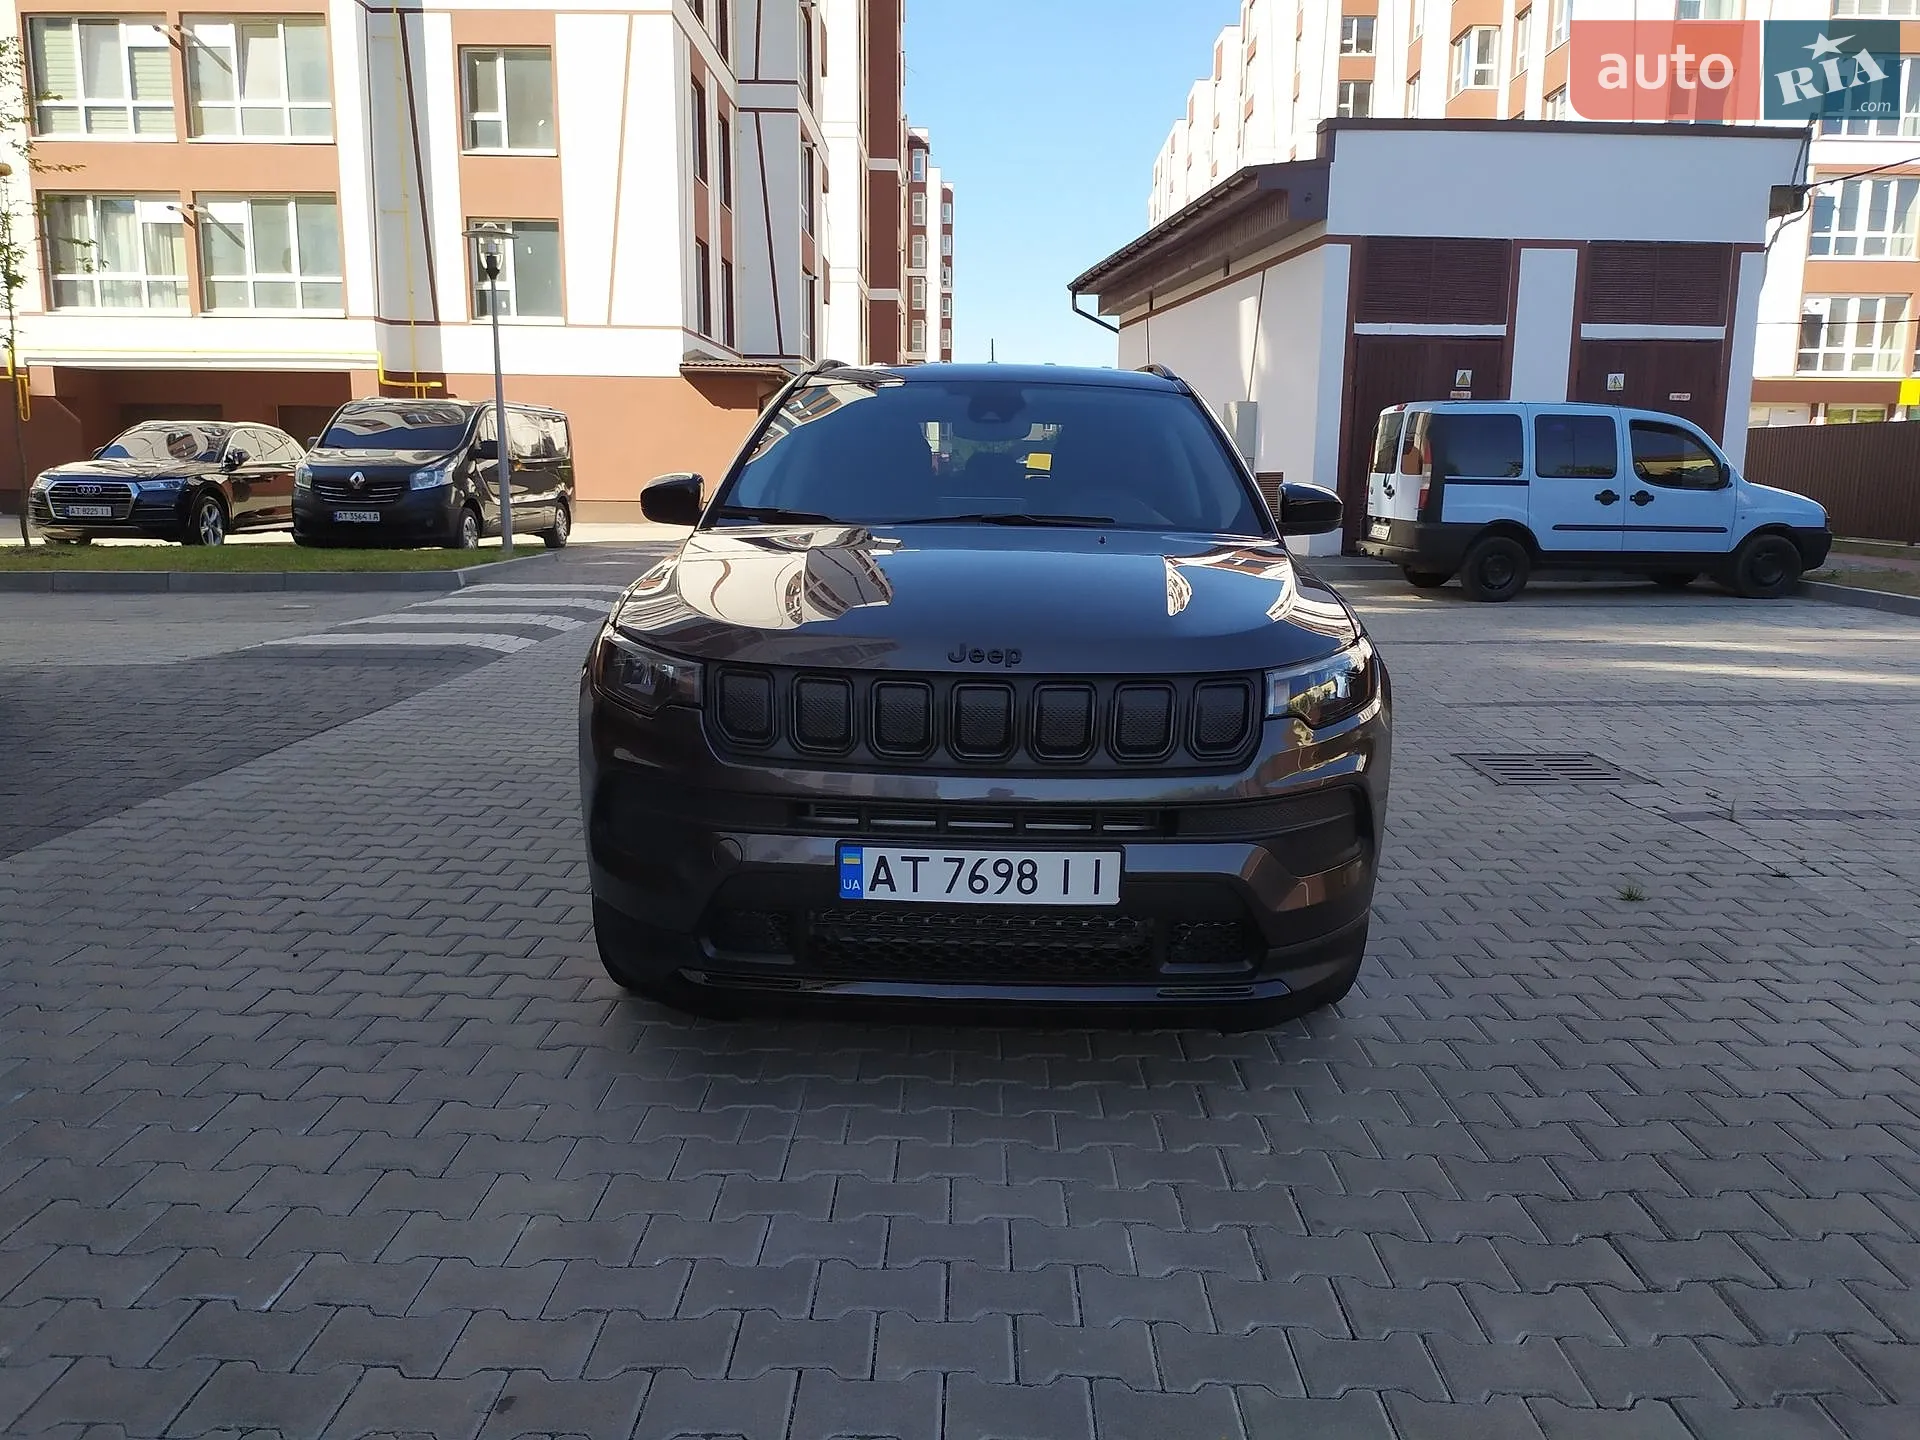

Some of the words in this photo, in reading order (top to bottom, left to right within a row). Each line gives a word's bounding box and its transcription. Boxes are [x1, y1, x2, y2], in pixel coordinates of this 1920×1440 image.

[947, 642, 1022, 668] Jeep
[843, 878, 861, 891] UA
[868, 855, 930, 893] AT
[943, 857, 1038, 895] 7698
